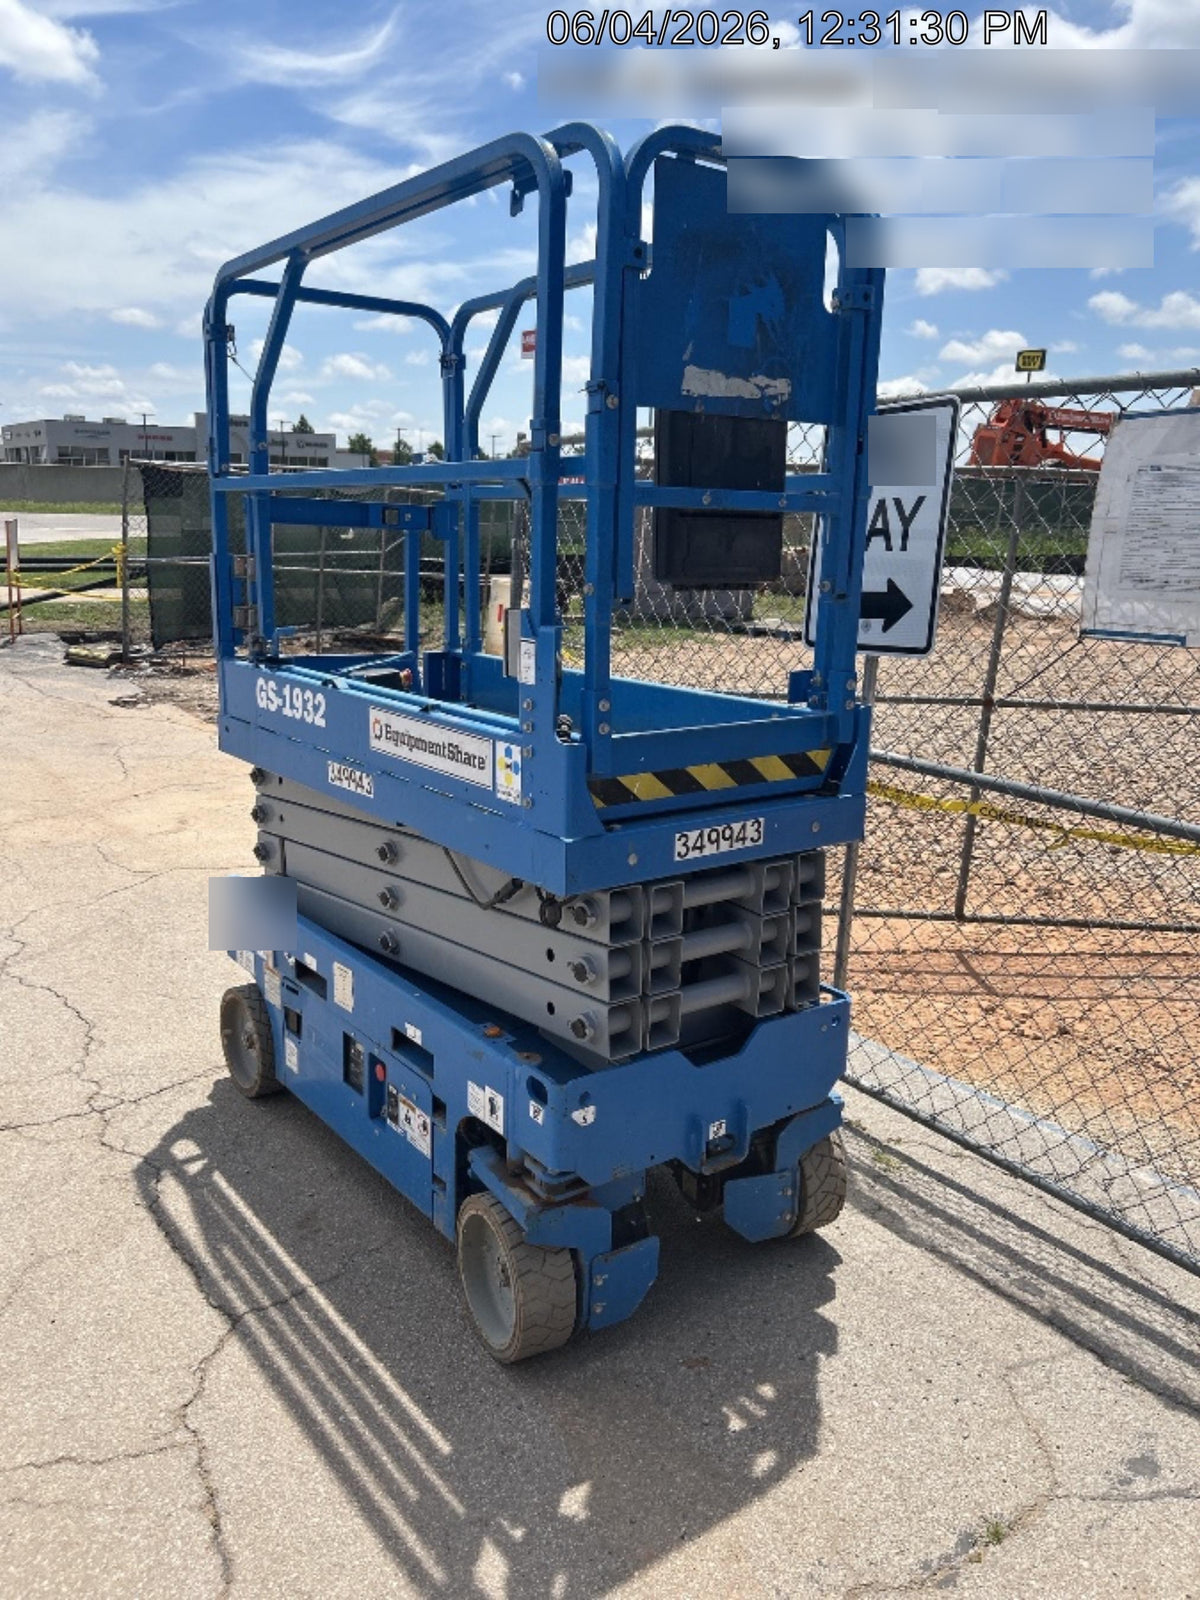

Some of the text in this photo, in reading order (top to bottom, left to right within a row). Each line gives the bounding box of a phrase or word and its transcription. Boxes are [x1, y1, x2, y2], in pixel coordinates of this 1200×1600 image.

[865, 495, 927, 552] AY
[255, 676, 327, 728] GS-1932
[385, 723, 486, 771] EquipmentShare
[677, 818, 762, 859] 349943
